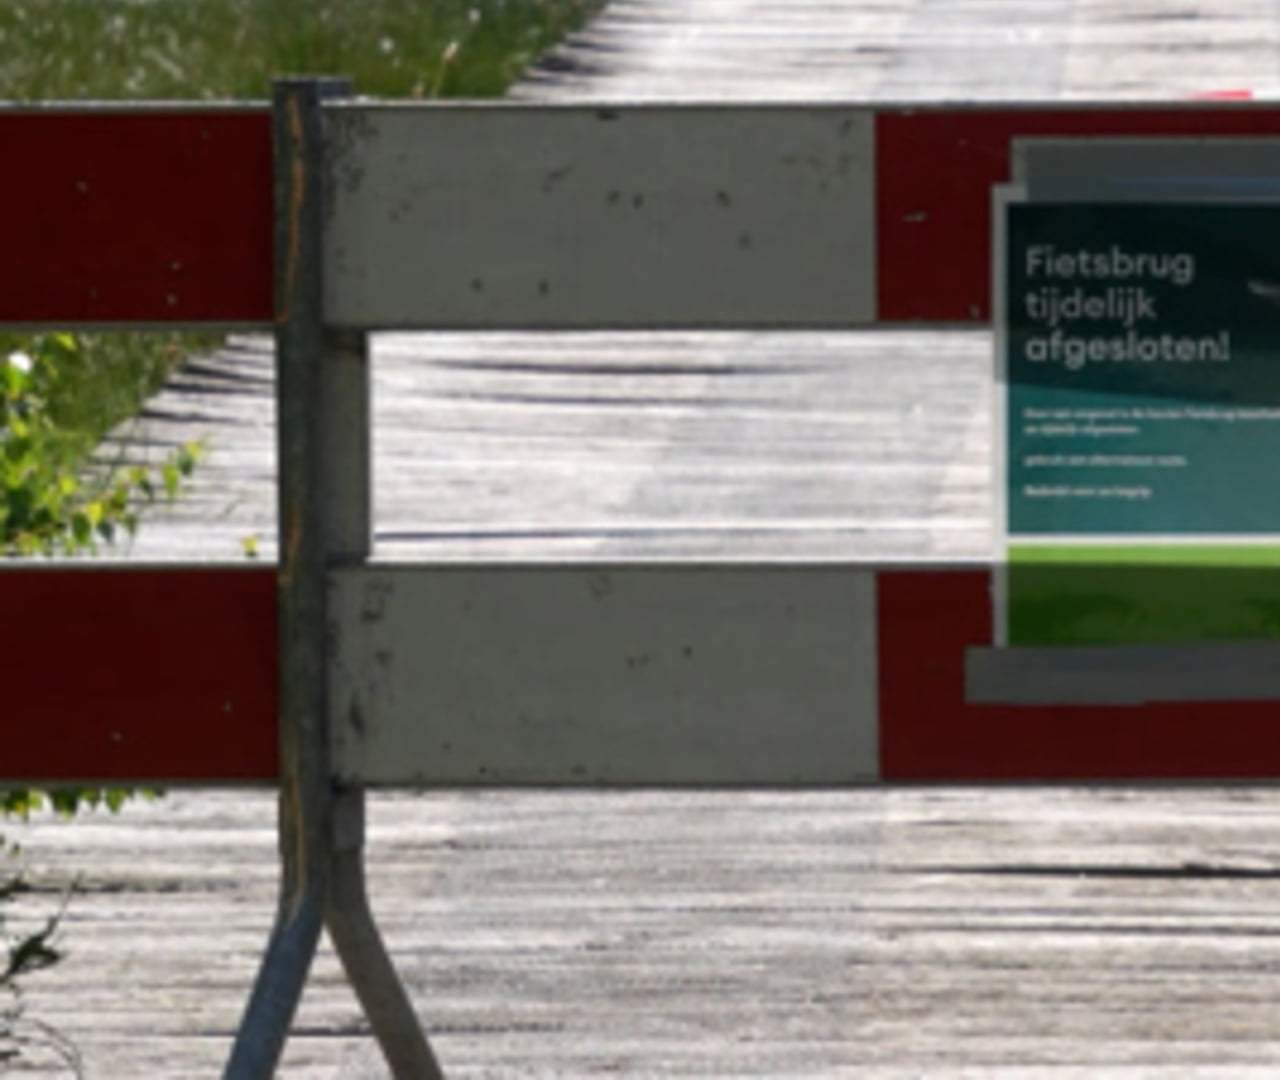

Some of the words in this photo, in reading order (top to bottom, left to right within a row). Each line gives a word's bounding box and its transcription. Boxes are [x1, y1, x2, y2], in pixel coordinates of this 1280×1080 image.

[1025, 244, 1194, 285] Fietsbrug
[1025, 287, 1157, 326] tijdelijk
[1025, 330, 1230, 369] afgesloten!
